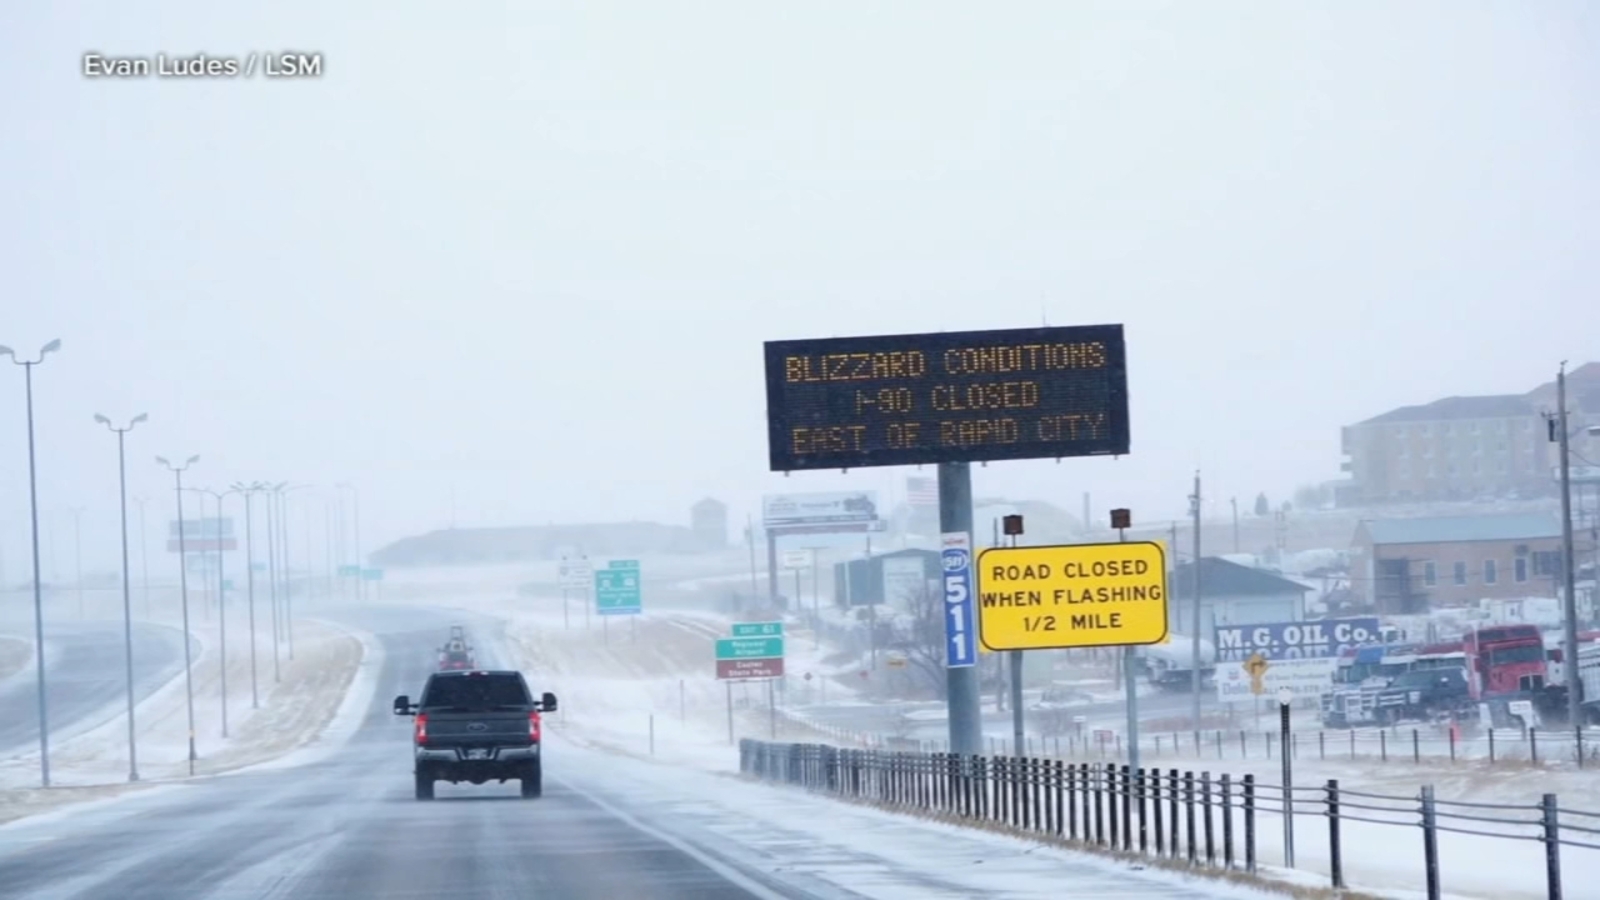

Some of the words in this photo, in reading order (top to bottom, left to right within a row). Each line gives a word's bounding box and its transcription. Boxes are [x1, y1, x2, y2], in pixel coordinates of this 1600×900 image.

[785, 350, 926, 382] BLIZZARD
[943, 341, 1106, 375] CONDITIONS
[930, 380, 1039, 411] CLOSED
[792, 424, 867, 455] EAST
[886, 422, 922, 449] OF
[938, 417, 1019, 447] RAPID
[1037, 413, 1105, 442] CITY
[992, 563, 1051, 581] ROAD
[1063, 559, 1149, 579] CLOSED
[980, 590, 1042, 608] WHEN
[1053, 584, 1162, 605] FLASHING
[945, 576, 968, 661] 511
[1023, 615, 1057, 632] 1/2
[1071, 612, 1123, 630] MILE
[1217, 627, 1280, 648] M.G.
[1282, 624, 1330, 646] OIL
[1334, 623, 1376, 643] Co.
